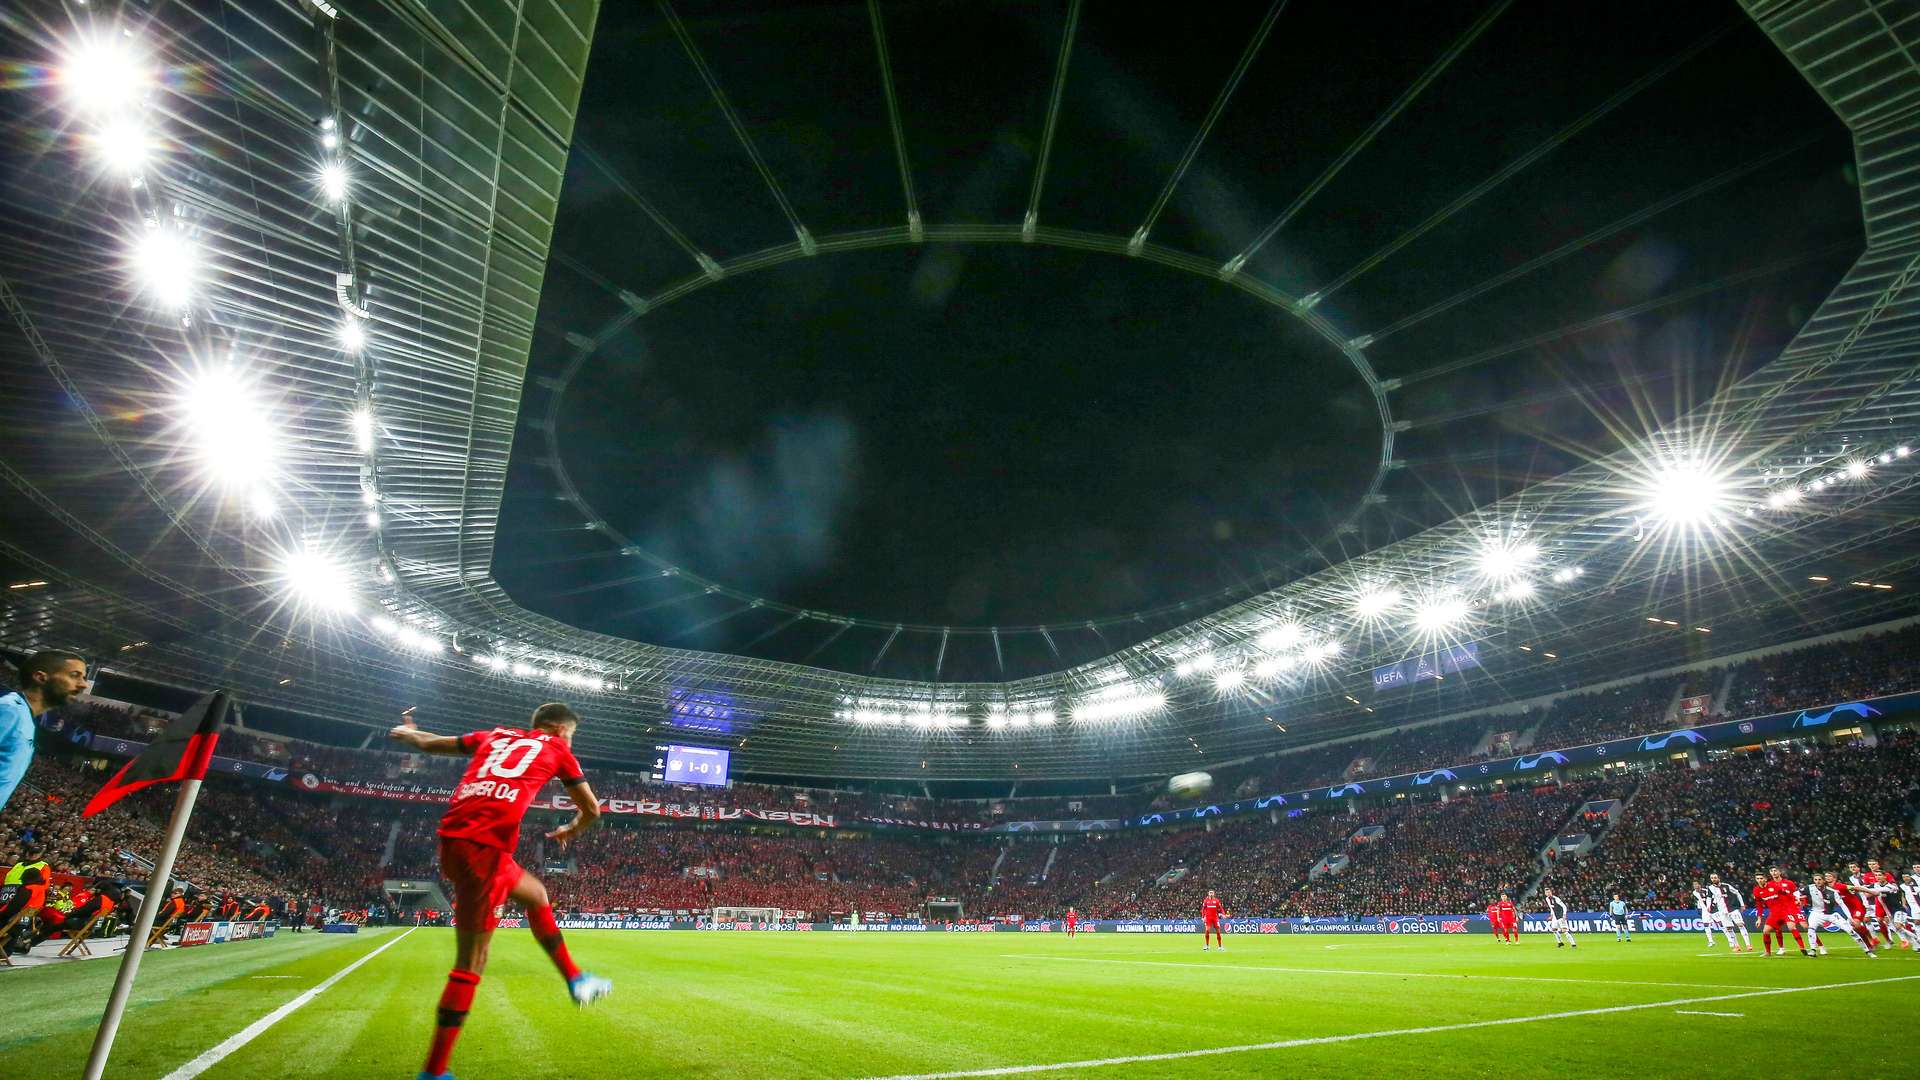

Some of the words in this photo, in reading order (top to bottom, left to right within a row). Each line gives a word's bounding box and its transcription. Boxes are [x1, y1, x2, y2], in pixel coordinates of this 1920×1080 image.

[1375, 671, 1403, 684] UEFA
[476, 737, 544, 778] 10
[689, 761, 709, 774] 1-0
[495, 783, 520, 802] 04
[598, 920, 623, 929] TASTE
[625, 921, 640, 929] NO
[641, 921, 671, 930] SUGAR
[890, 924, 902, 932] NO
[903, 924, 927, 932] SUGAR
[953, 924, 978, 933] pepsi
[1116, 924, 1144, 932] MAXIMUM
[1144, 924, 1162, 932] TASTE
[1163, 924, 1173, 932] NO
[1174, 924, 1196, 932] SUGAR
[1233, 922, 1259, 934] pepsi
[1259, 922, 1278, 934] MAX
[1315, 924, 1350, 932] CHAMPIONS
[1351, 924, 1376, 932] LEAGUE
[1402, 920, 1439, 934] pepsi
[1441, 920, 1469, 933] MAX
[1594, 920, 1636, 932] TASE
[1641, 919, 1668, 931] NO
